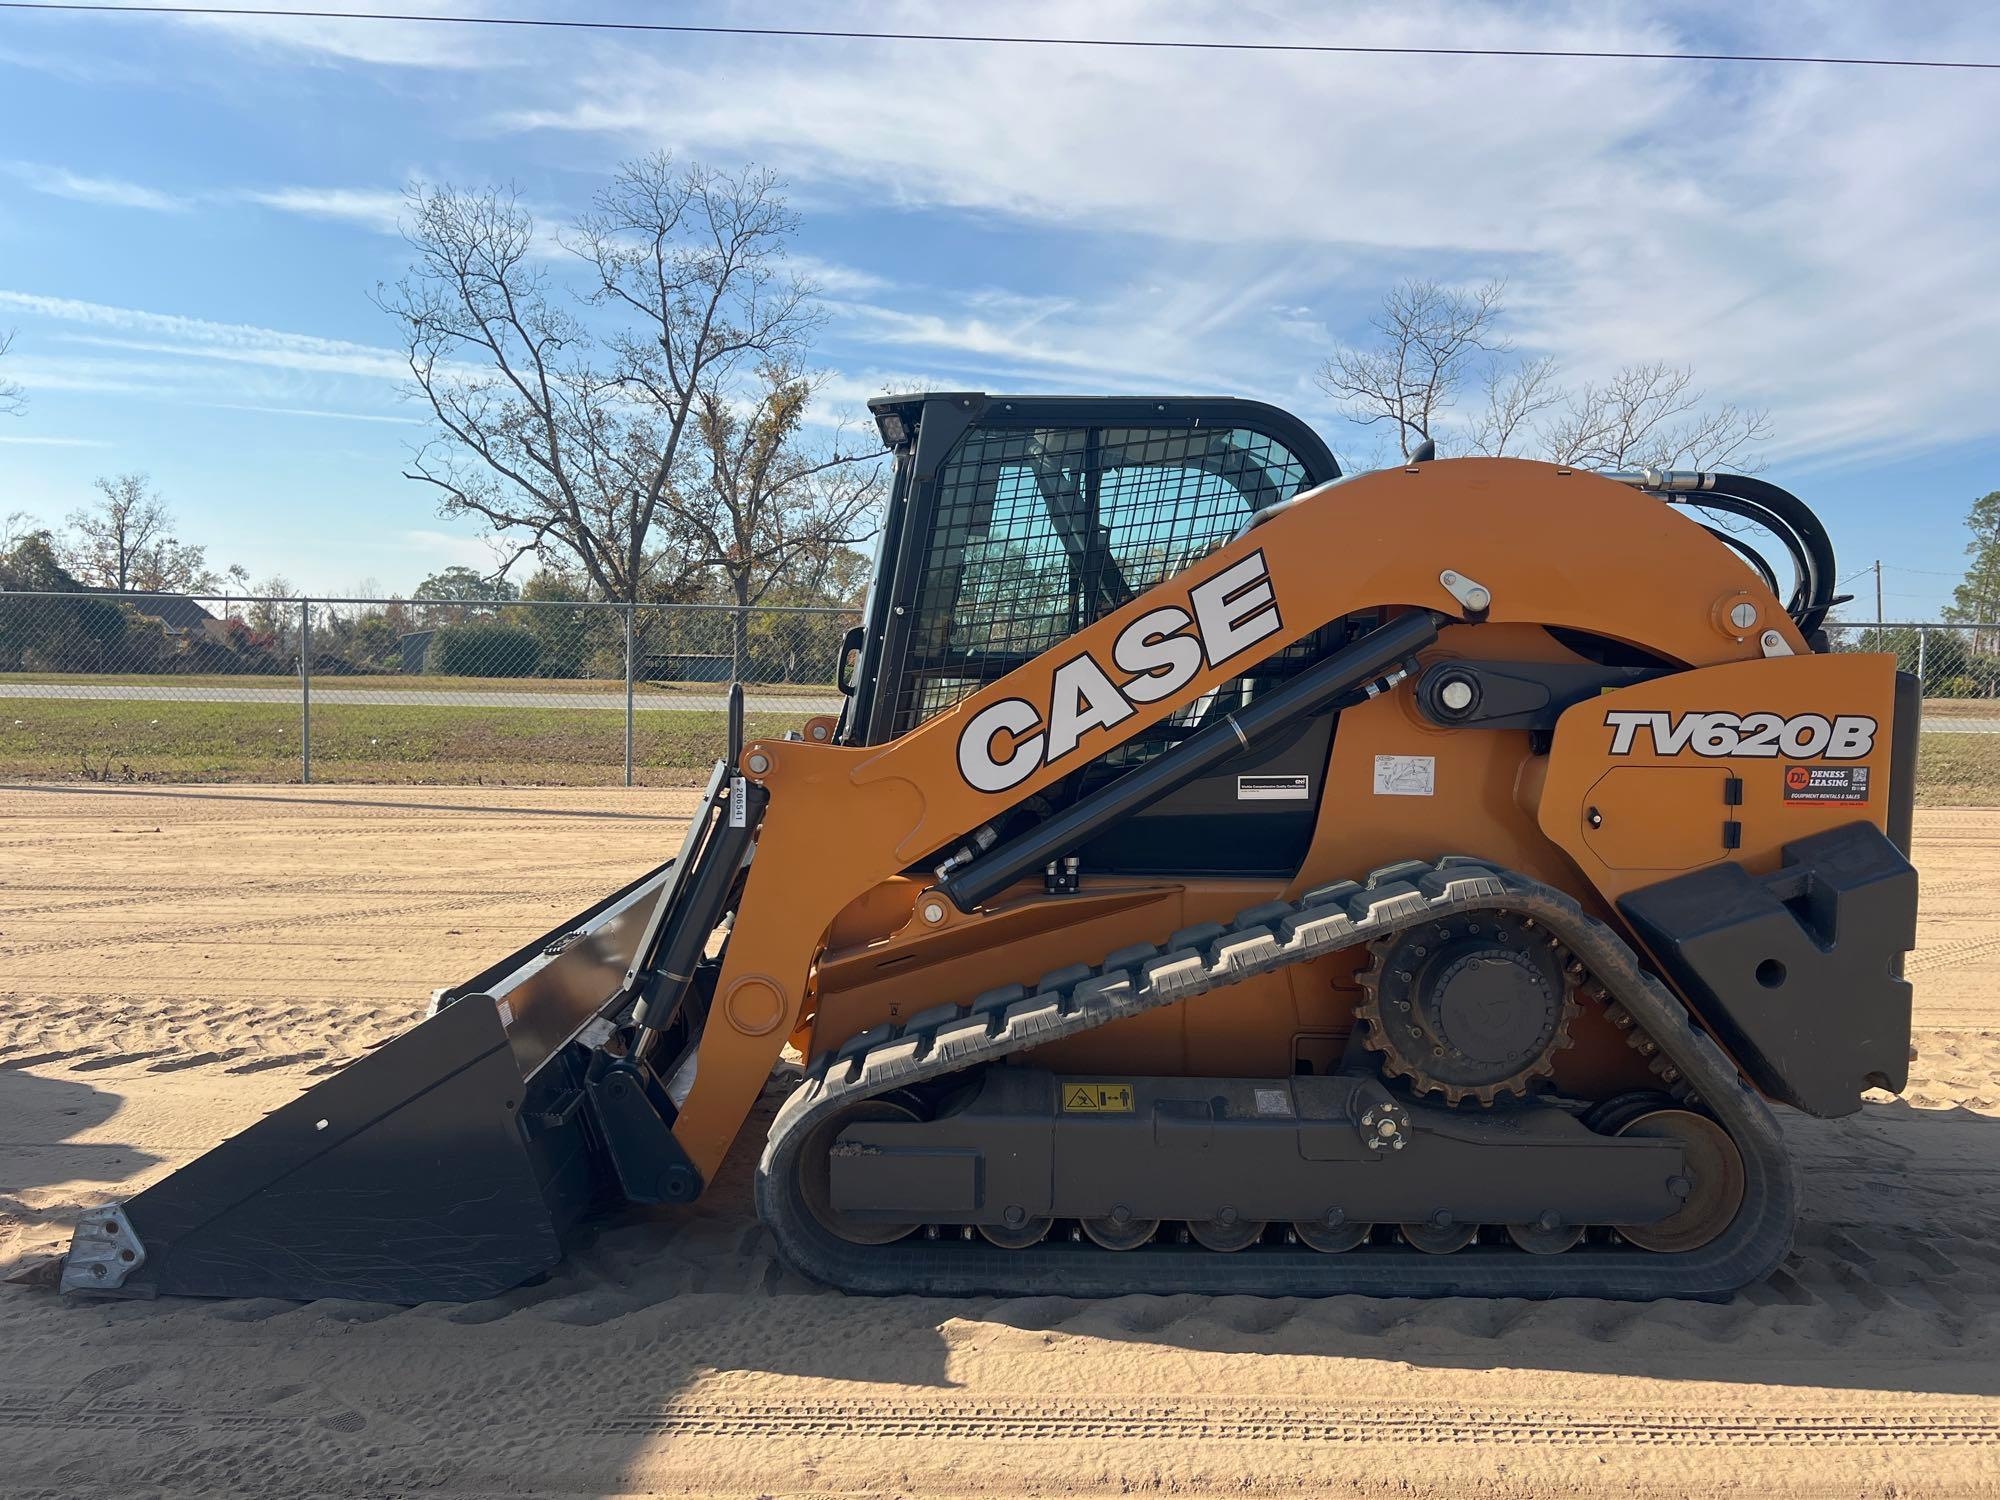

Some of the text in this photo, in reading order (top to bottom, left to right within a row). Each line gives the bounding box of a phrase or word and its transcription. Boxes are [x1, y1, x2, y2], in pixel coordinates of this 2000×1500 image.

[956, 547, 1283, 793] CASE
[1603, 710, 1878, 760] TV620B
[1790, 772, 1806, 784] DL
[1809, 779, 1848, 787] LEASING
[736, 788, 744, 820] 206541
